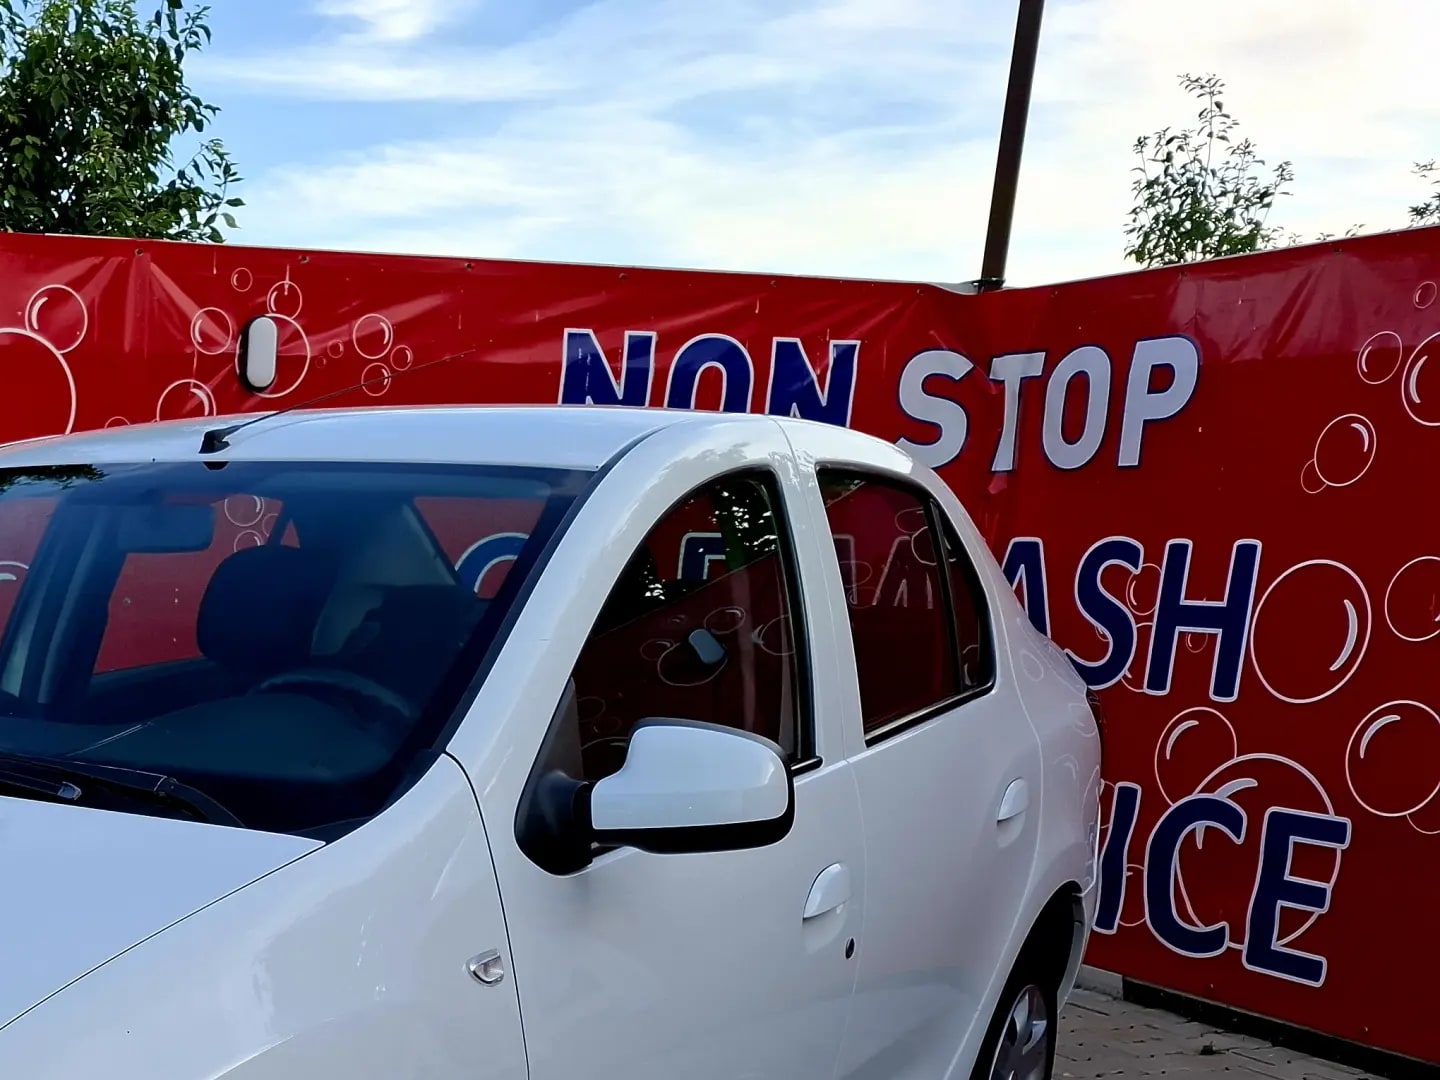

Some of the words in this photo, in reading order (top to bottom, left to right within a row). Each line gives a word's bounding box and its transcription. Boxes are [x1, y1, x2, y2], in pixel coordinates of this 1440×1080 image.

[558, 328, 861, 428] NON
[893, 333, 1202, 474] STOP
[1091, 780, 1352, 988] ICE
